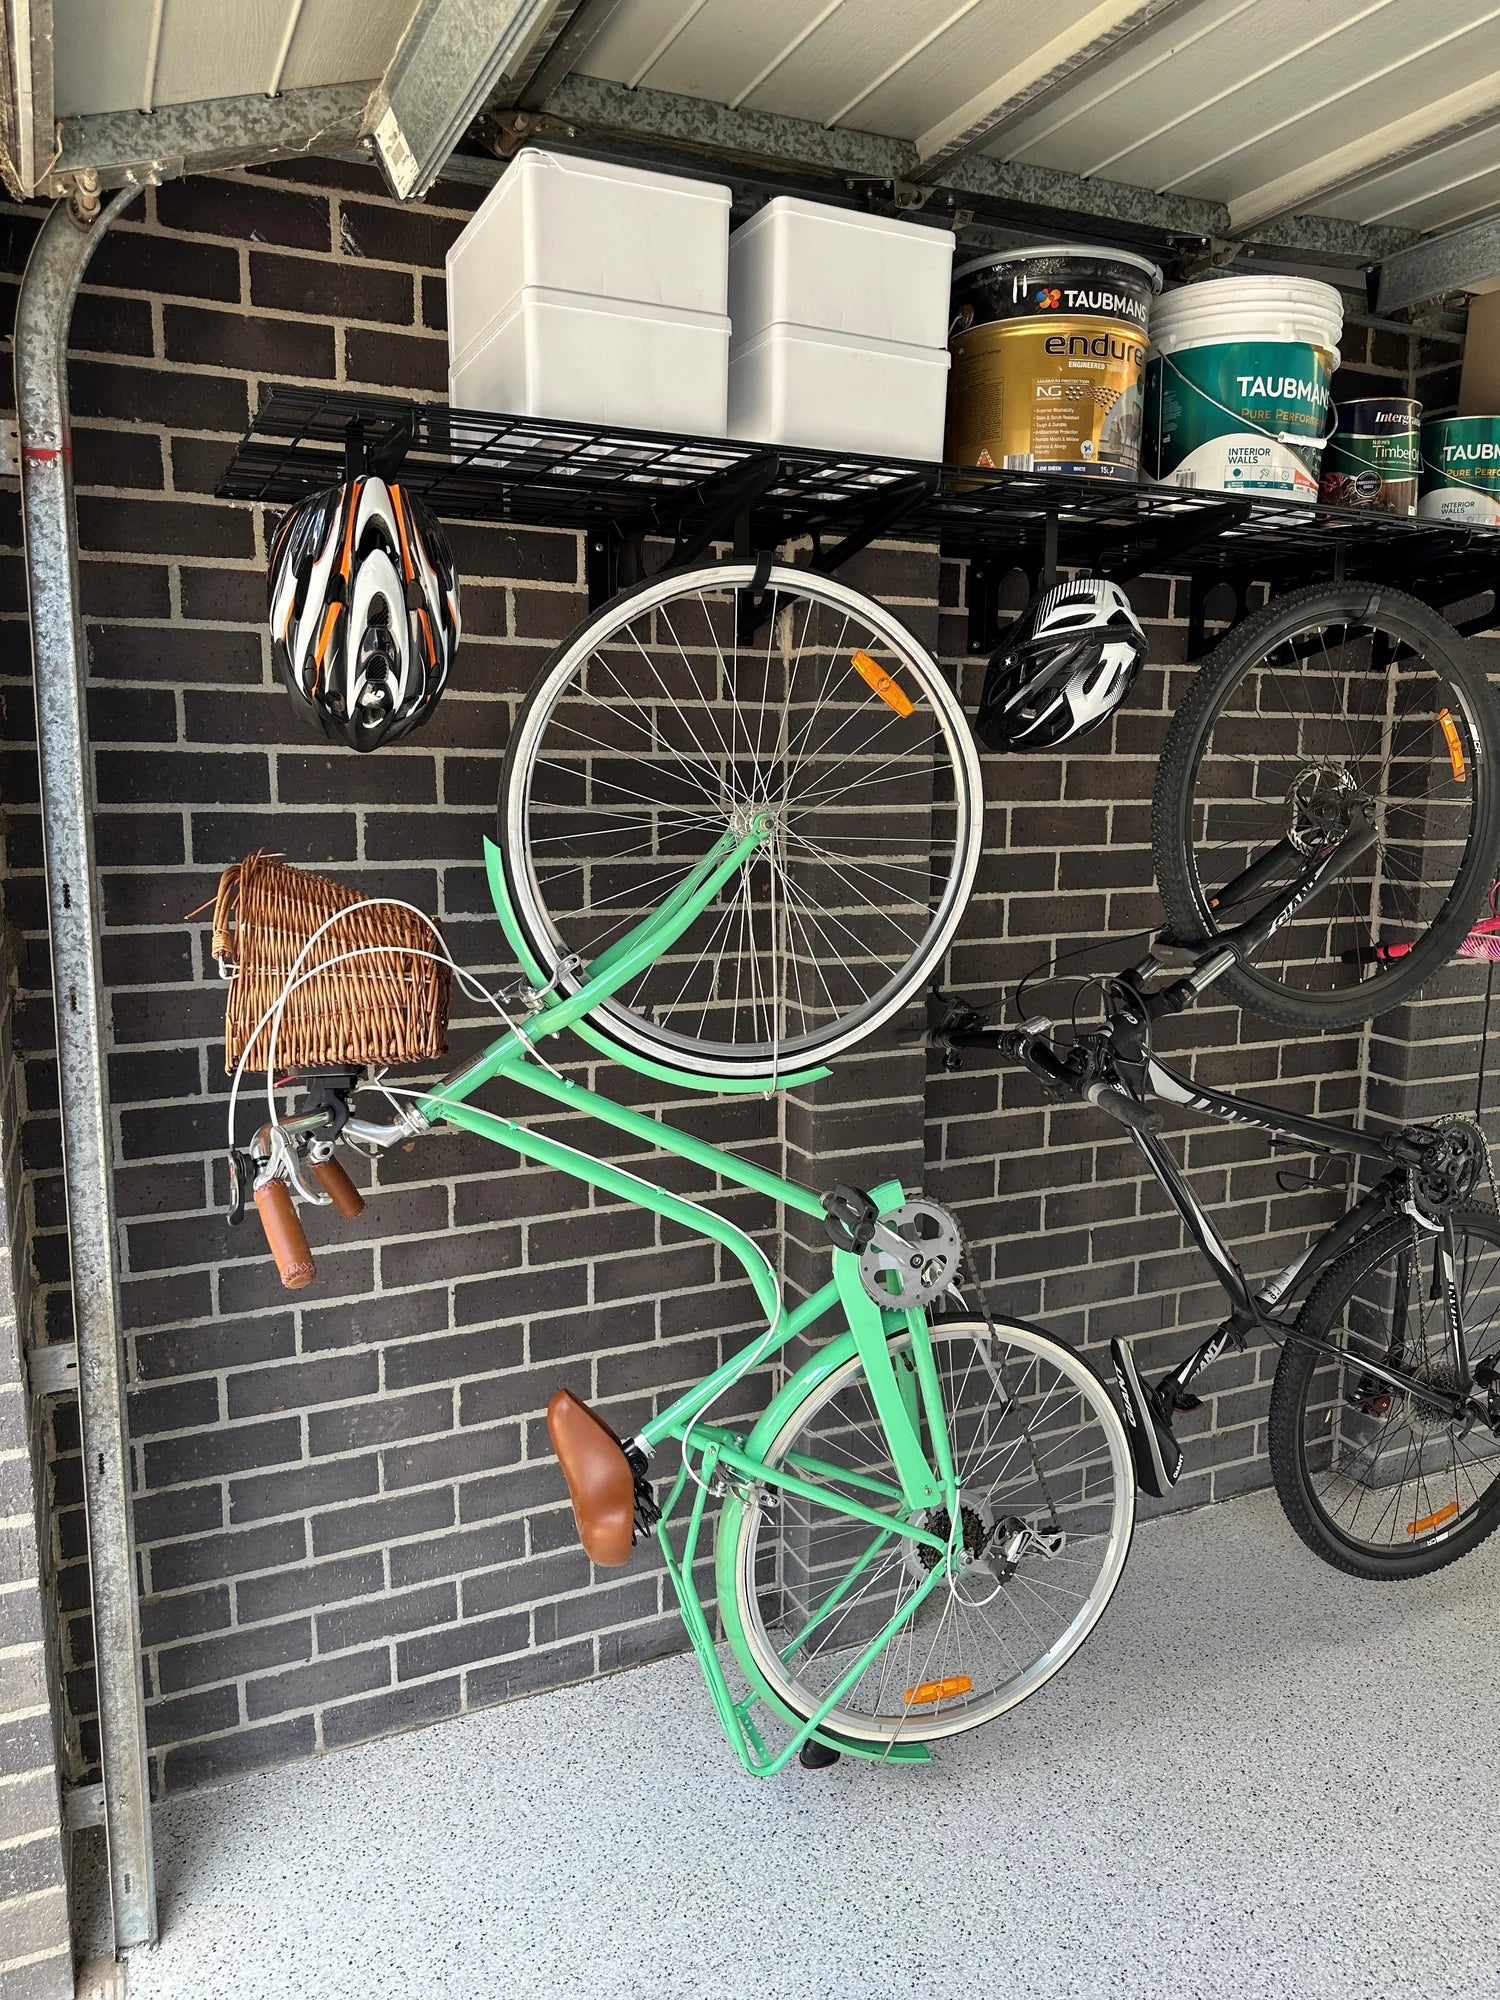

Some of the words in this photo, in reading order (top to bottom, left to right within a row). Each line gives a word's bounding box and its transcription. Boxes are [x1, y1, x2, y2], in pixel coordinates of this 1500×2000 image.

[1064, 290, 1146, 322] TAUBMANS
[1045, 334, 1143, 368] endure
[1069, 361, 1105, 369] ENGINEERED
[1037, 386, 1062, 397] NG
[1241, 408, 1271, 419] PURE
[1276, 410, 1322, 426] PERFORM
[1228, 448, 1271, 456] INTERIOR
[1228, 456, 1259, 464] WALLS
[1447, 470, 1471, 478] PURE
[1113, 1360, 1136, 1428] GIANT
[1172, 1454, 1183, 1479] GIANT
